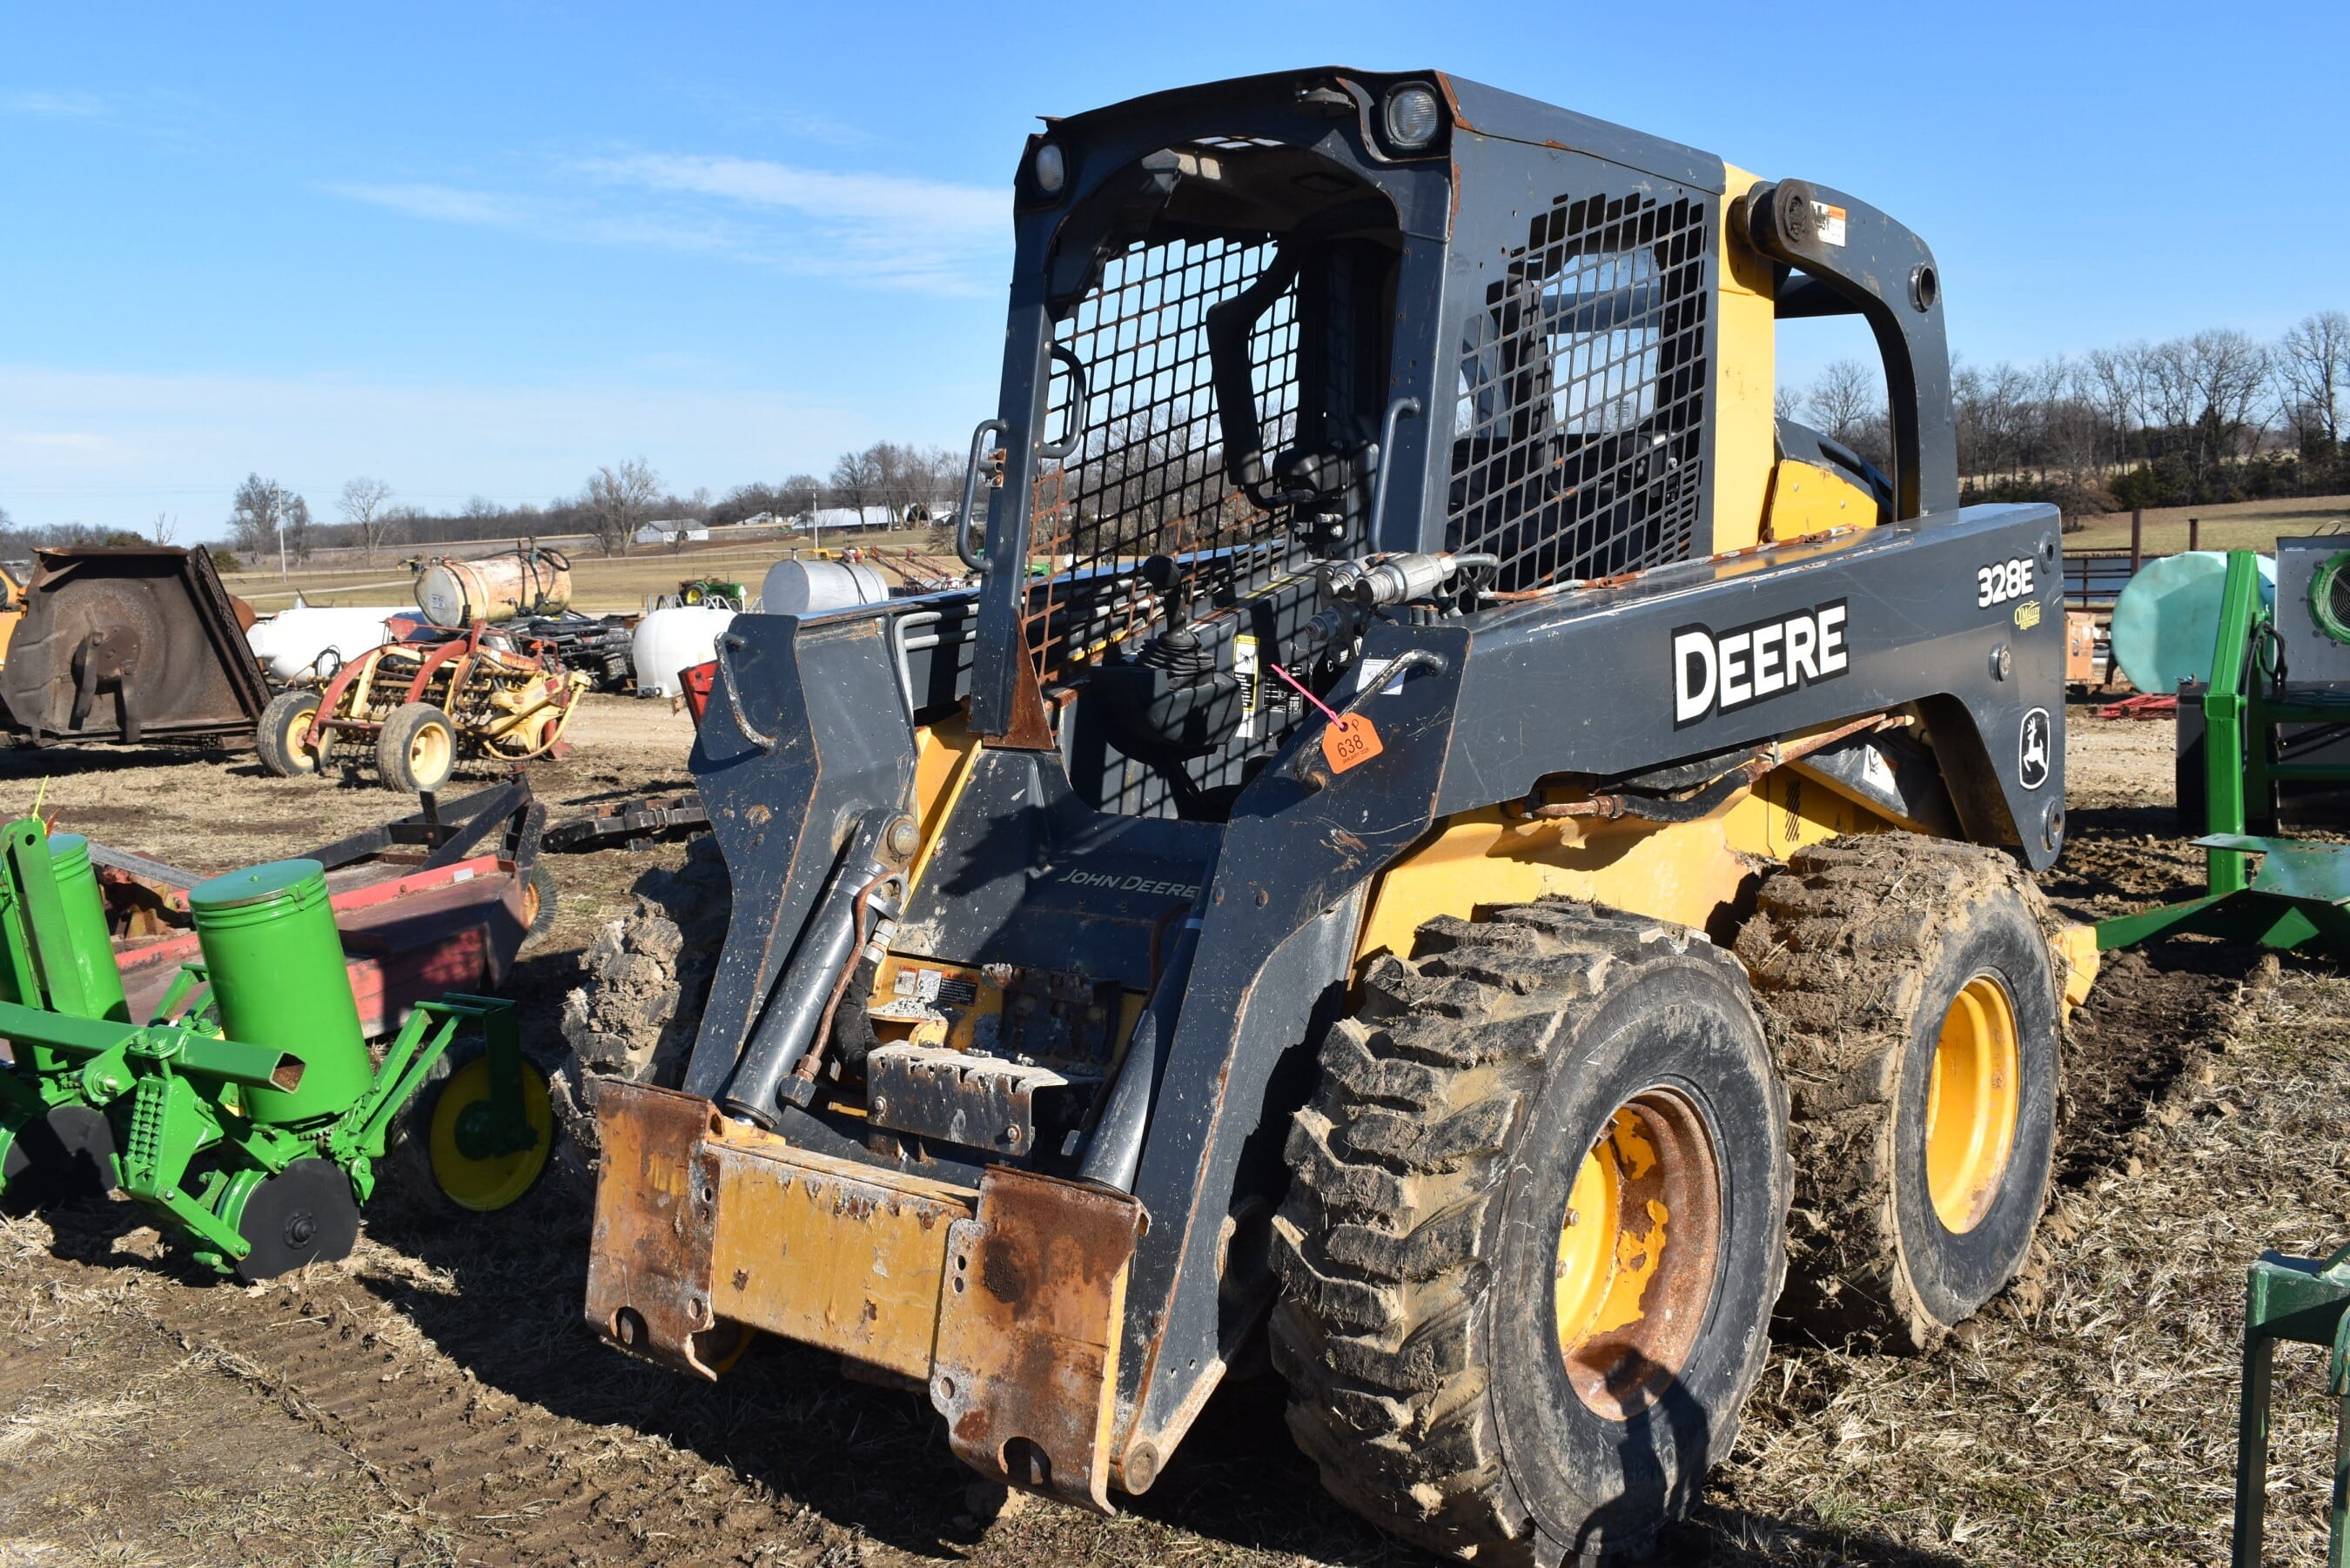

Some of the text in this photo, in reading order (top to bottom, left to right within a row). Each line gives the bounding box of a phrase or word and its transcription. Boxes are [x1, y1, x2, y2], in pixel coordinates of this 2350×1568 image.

[1977, 558, 2034, 607] 328E
[1674, 605, 1847, 722] DEERE
[1337, 734, 1364, 758] 638
[1058, 868, 1201, 898] JOHN DEERE
